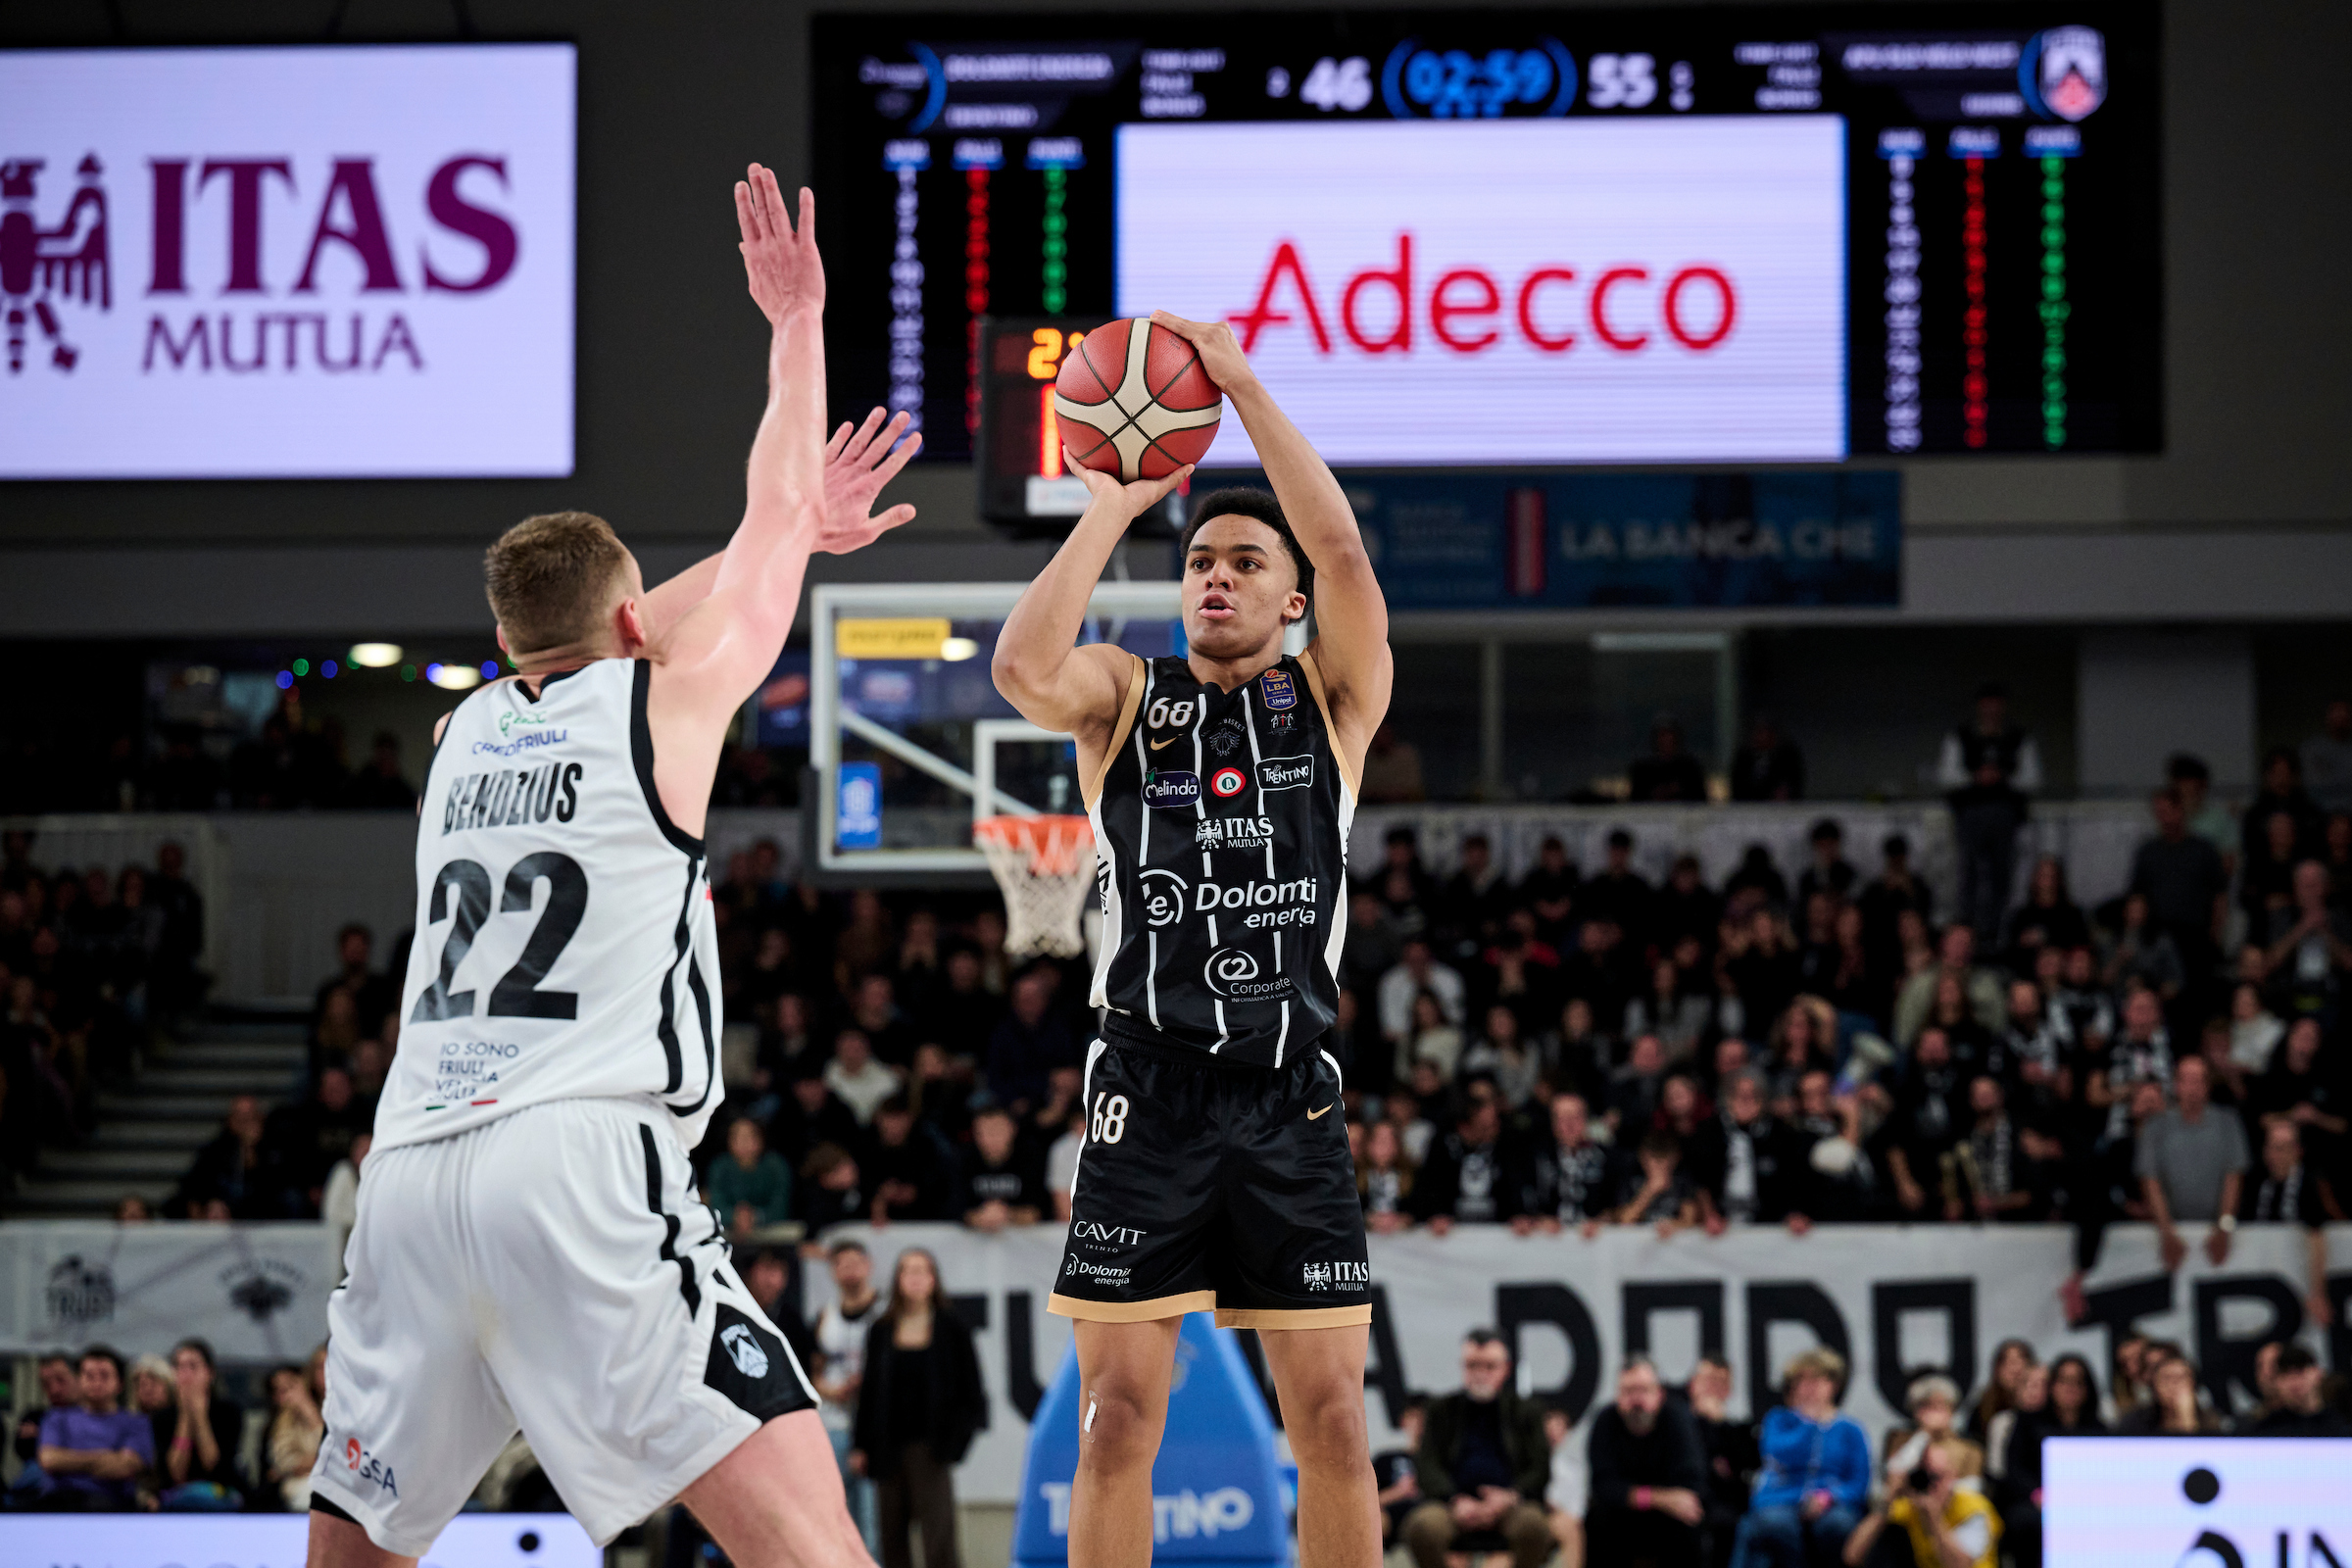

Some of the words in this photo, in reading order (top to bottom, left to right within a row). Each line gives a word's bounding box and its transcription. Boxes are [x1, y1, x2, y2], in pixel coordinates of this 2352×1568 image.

[1301, 56, 1372, 111] 46
[1405, 49, 1553, 105] 02:59
[1589, 53, 1657, 108] 55
[144, 153, 520, 295] ITAS
[1229, 232, 1736, 354] Adecco
[142, 313, 424, 373] MUTUA
[1561, 521, 1616, 561] LA
[1623, 519, 1784, 561] BANCA
[1266, 682, 1290, 692] LBA
[1148, 697, 1195, 729] 68
[1263, 764, 1309, 784] TRENTINO
[1146, 779, 1198, 799] Melinda
[1225, 817, 1274, 838] ITAS
[1227, 838, 1264, 849] MUTUA
[411, 852, 588, 1023] 22
[1230, 977, 1291, 996] Corporate
[440, 1042, 460, 1055] IO
[465, 1042, 519, 1058] SONO
[1092, 1091, 1129, 1145] 68
[1074, 1221, 1147, 1246] CAVIT
[1095, 1277, 1130, 1287] energia
[1334, 1261, 1369, 1282] ITAS
[1335, 1282, 1364, 1292] MUTUA
[1040, 1481, 1255, 1544] TTINO
